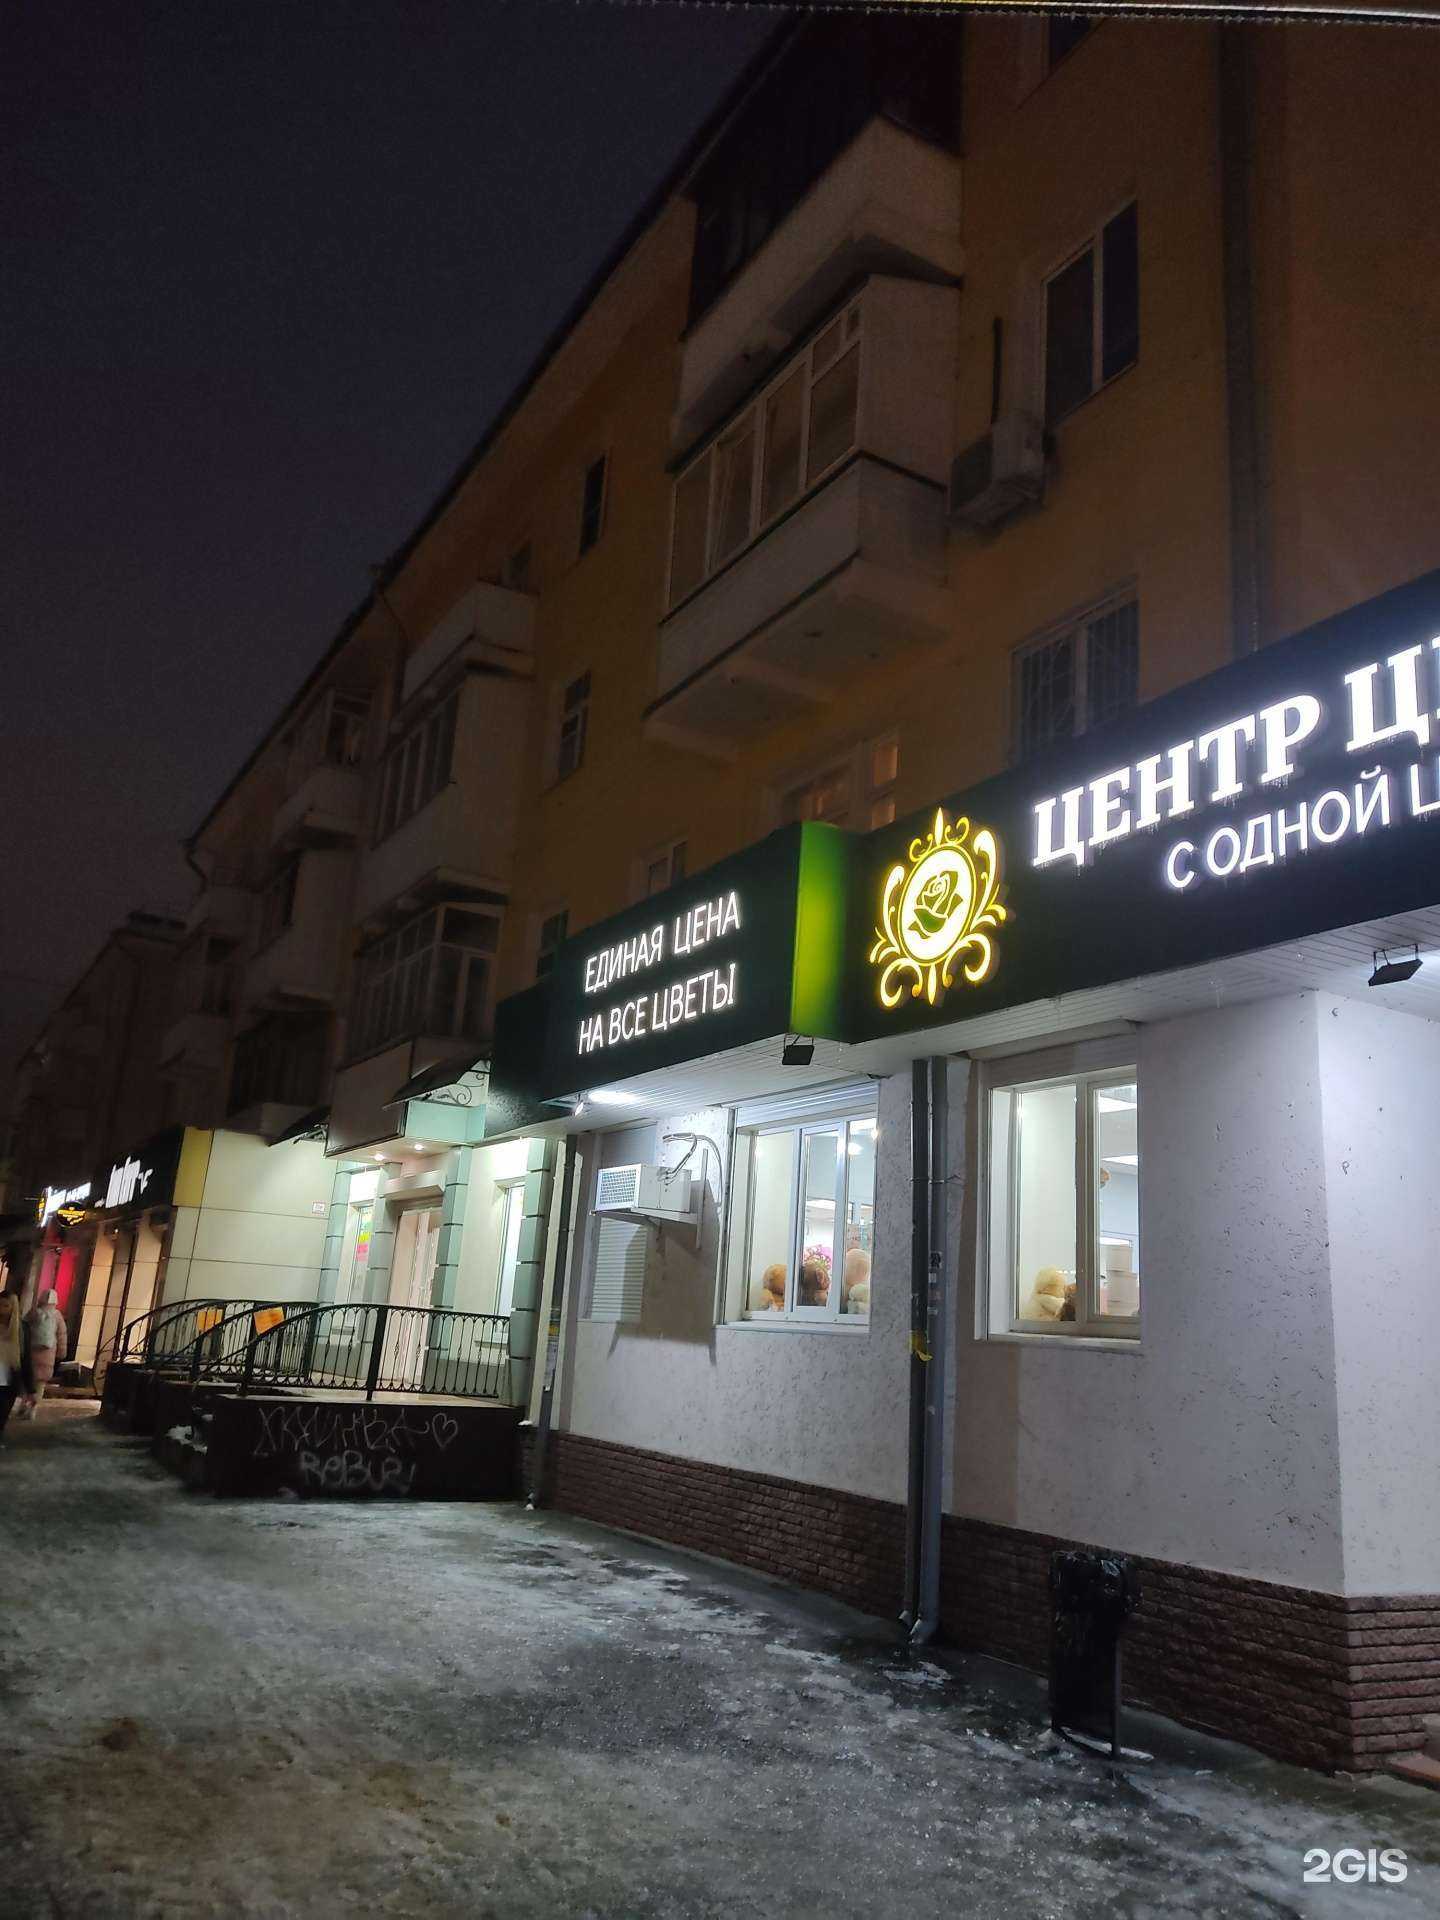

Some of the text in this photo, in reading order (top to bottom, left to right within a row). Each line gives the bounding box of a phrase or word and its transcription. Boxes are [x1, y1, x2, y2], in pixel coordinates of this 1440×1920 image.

[1031, 637, 1440, 866] ЦЕНТР Ц
[1166, 840, 1197, 888] С
[1206, 764, 1391, 877] ОДНОЙ
[584, 891, 741, 993] ЕДИНАЯ ЦЕНА
[578, 963, 736, 1055] НА ВСЕ ЦВЕТЫ
